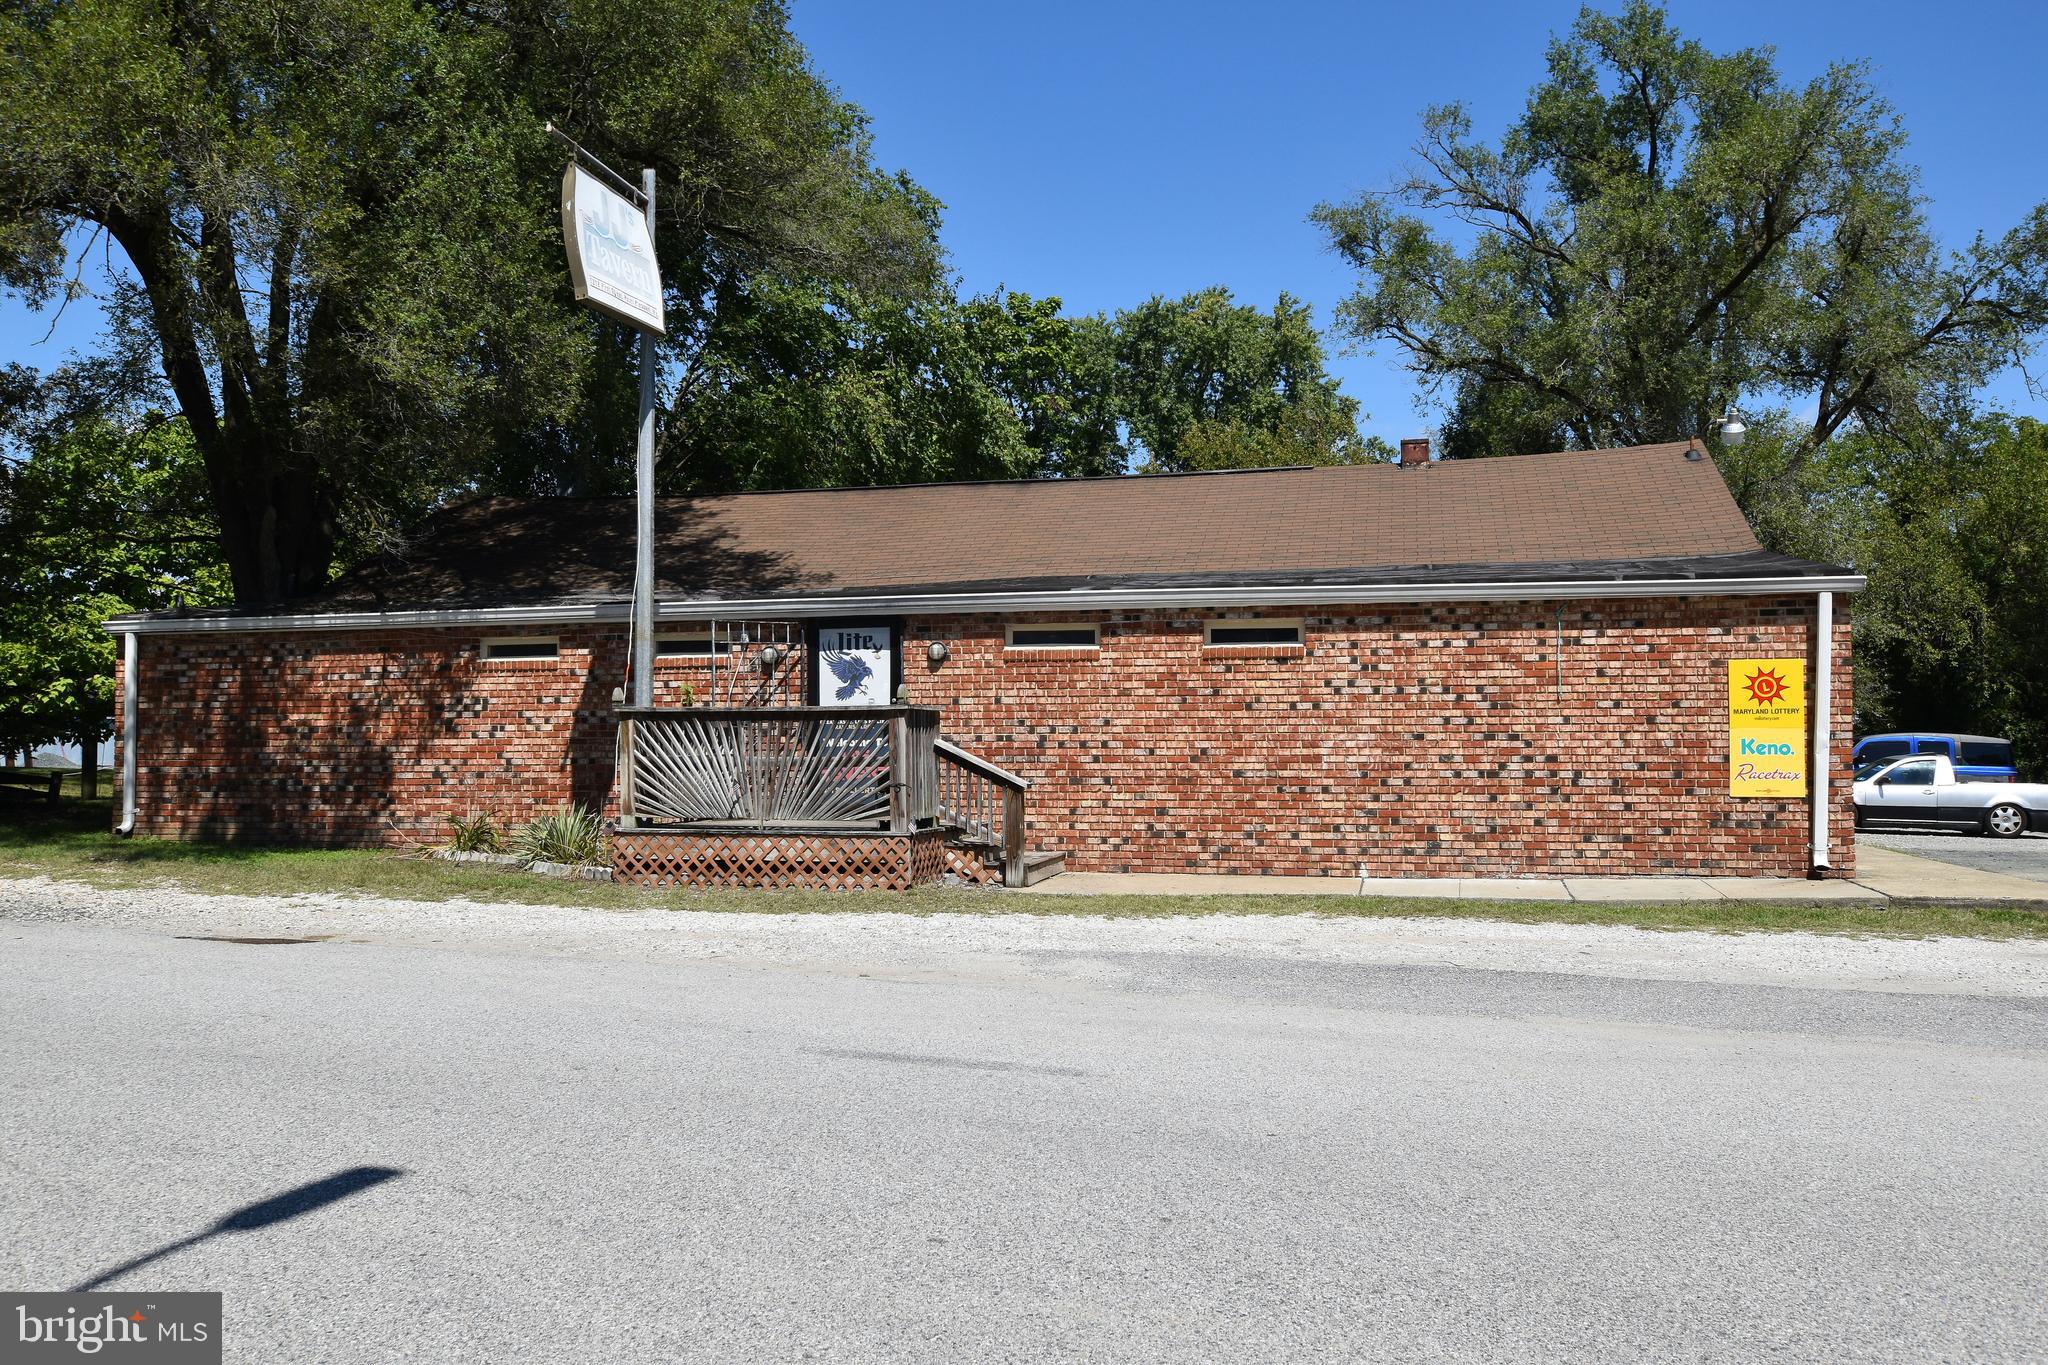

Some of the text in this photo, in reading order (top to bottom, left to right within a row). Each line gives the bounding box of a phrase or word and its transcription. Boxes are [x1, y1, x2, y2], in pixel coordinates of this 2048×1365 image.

[587, 233, 653, 292] Tavern
[837, 632, 875, 652] lite
[1740, 738, 1795, 756] Keno.
[1734, 763, 1802, 782] Racetrax
